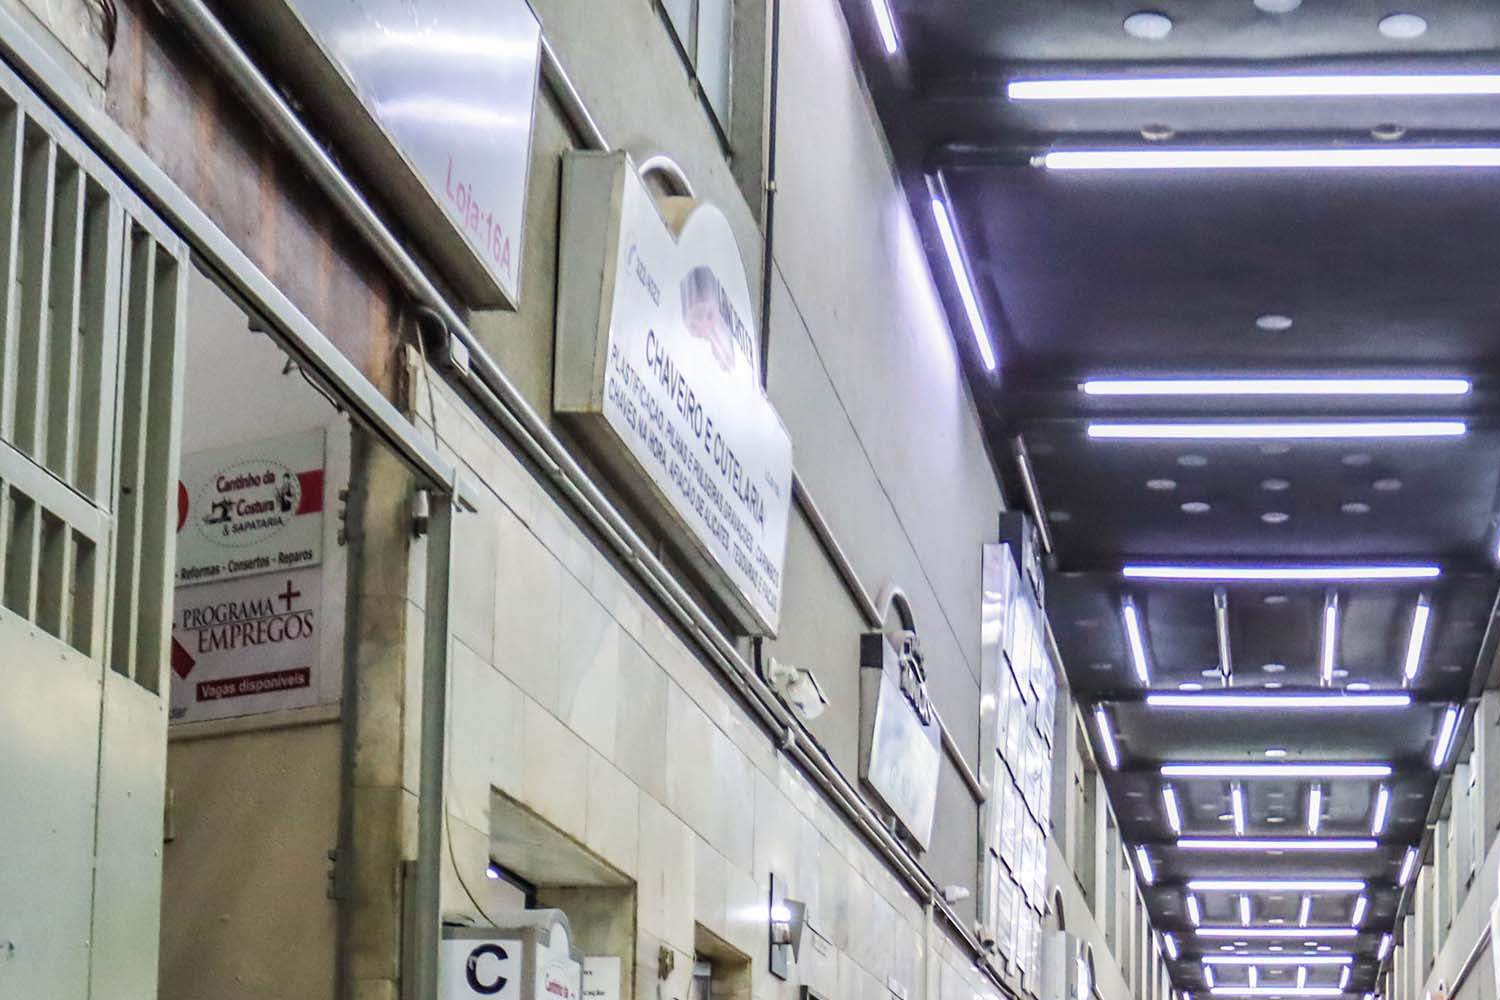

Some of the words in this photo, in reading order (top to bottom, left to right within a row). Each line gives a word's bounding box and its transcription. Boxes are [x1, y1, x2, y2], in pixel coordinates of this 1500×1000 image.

[608, 377, 637, 431] CHAVES
[638, 415, 647, 443] NA
[646, 329, 702, 438] CHAVEIRO
[705, 416, 712, 454] E
[715, 432, 764, 529] CUTELARIA
[216, 472, 261, 494] Cantinho
[262, 470, 275, 485] da
[236, 500, 275, 517] Costura
[232, 516, 284, 534] SAPATARIA
[180, 563, 220, 581] Reformas
[228, 556, 270, 574] Consertos
[278, 549, 313, 566] Reparos
[183, 597, 275, 629] PROGRAMA
[197, 612, 313, 653] EMPREGOS
[201, 679, 235, 698] Vagas
[238, 671, 305, 695] disponíveis
